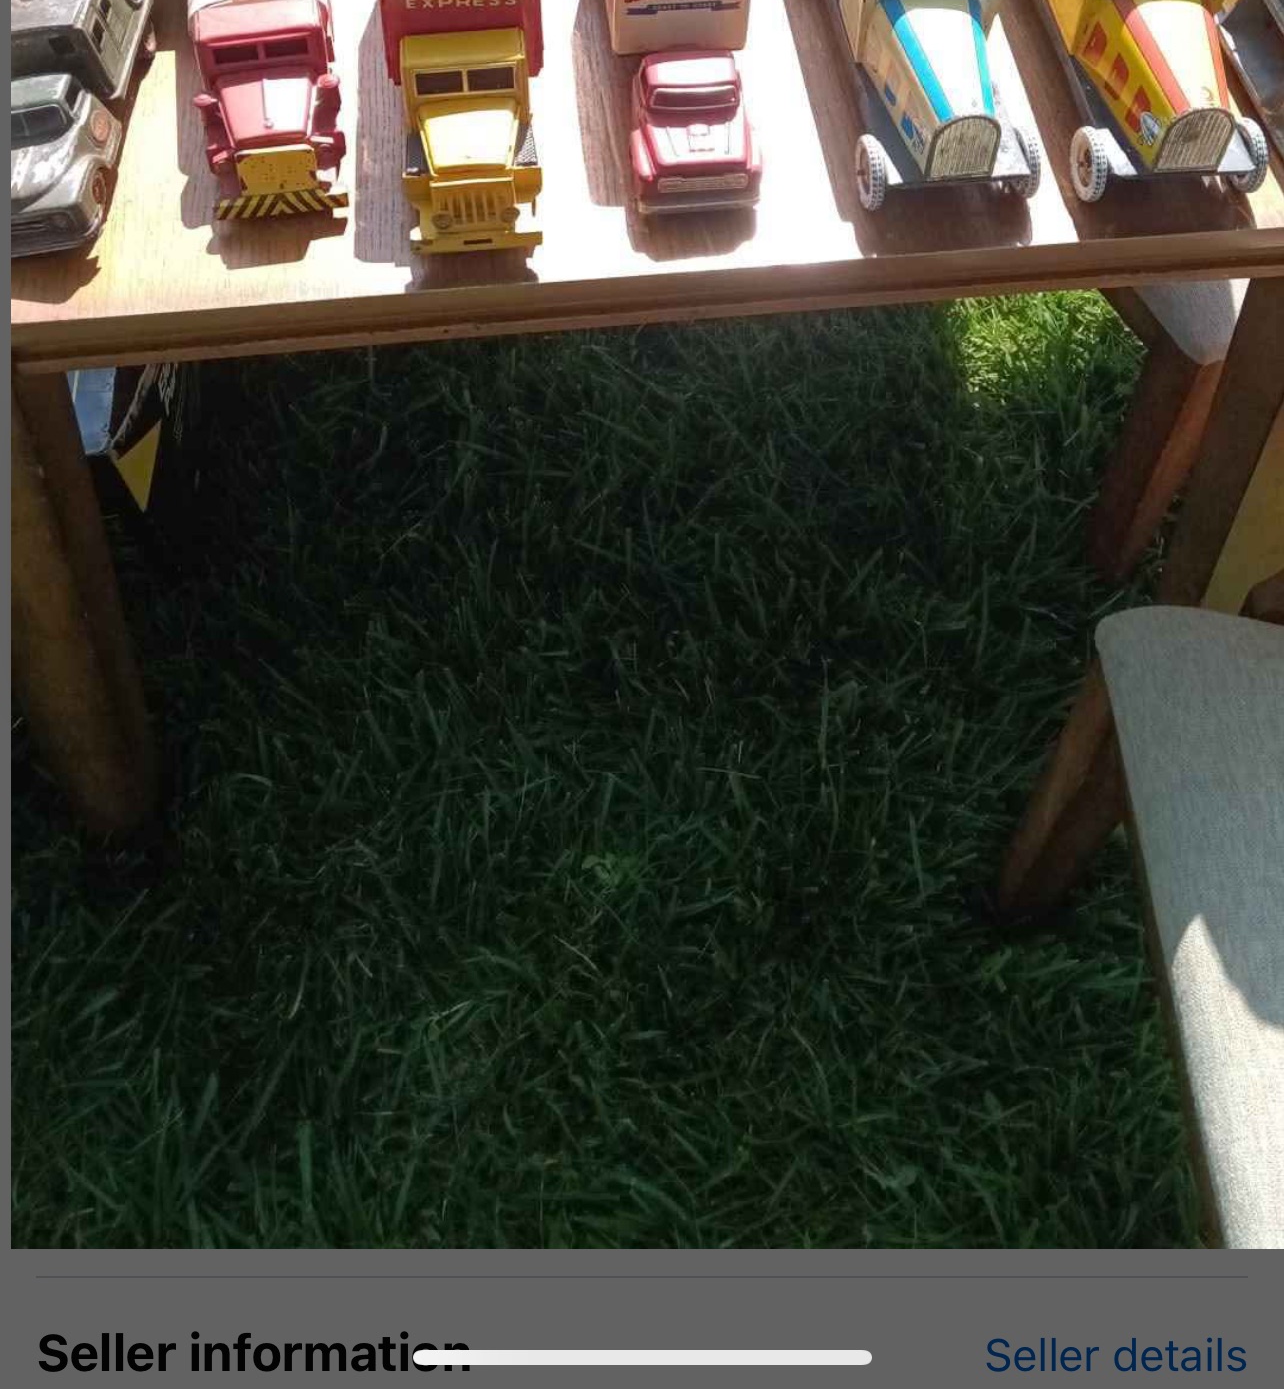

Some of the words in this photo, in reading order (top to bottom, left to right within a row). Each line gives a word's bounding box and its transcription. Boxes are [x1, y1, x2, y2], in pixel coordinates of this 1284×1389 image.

[39, 1333, 176, 1372] Seller
[191, 1331, 470, 1372] information
[987, 1338, 1099, 1372] Seller
[1114, 1338, 1246, 1372] details
